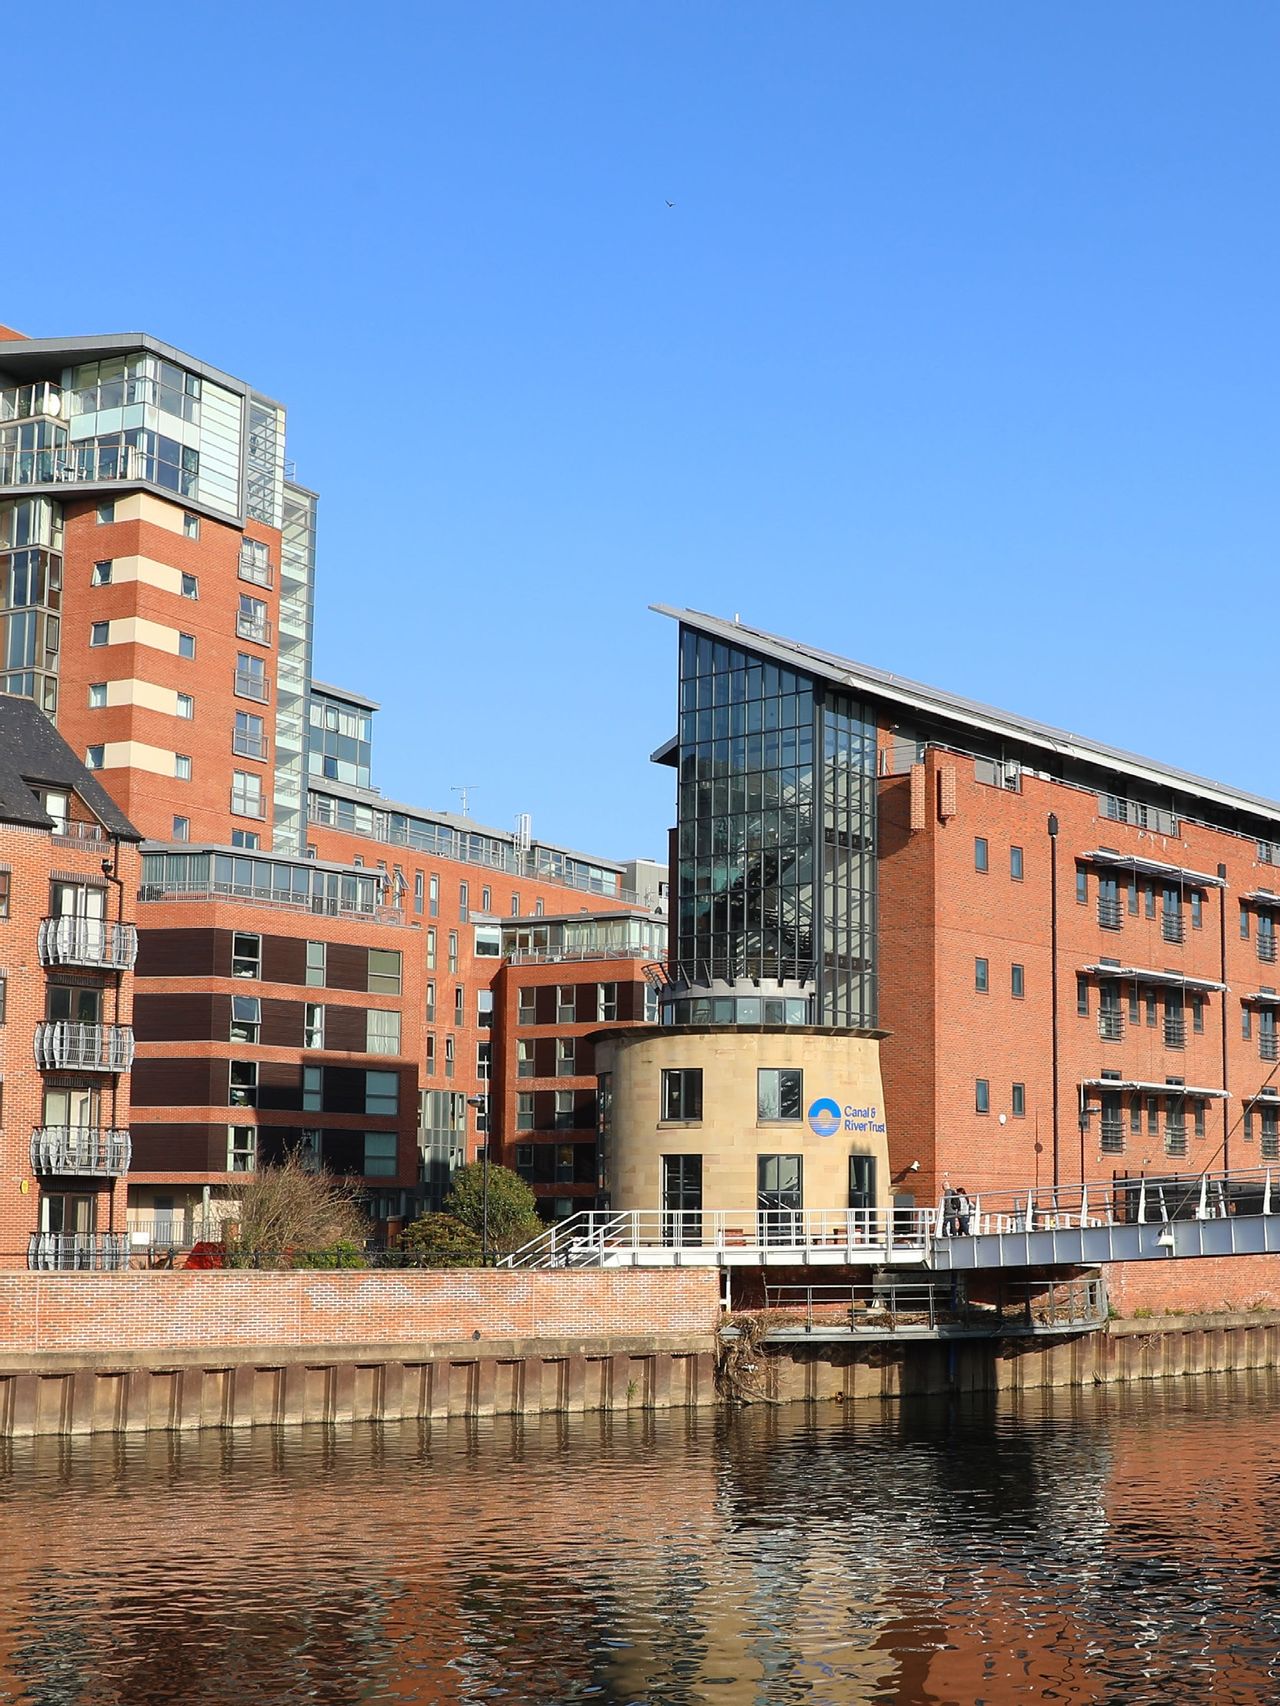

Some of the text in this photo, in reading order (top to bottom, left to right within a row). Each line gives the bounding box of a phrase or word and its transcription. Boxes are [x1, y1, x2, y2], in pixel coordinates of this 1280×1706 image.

[844, 1106, 876, 1118] Canal &
[844, 1119, 885, 1133] River Trust
